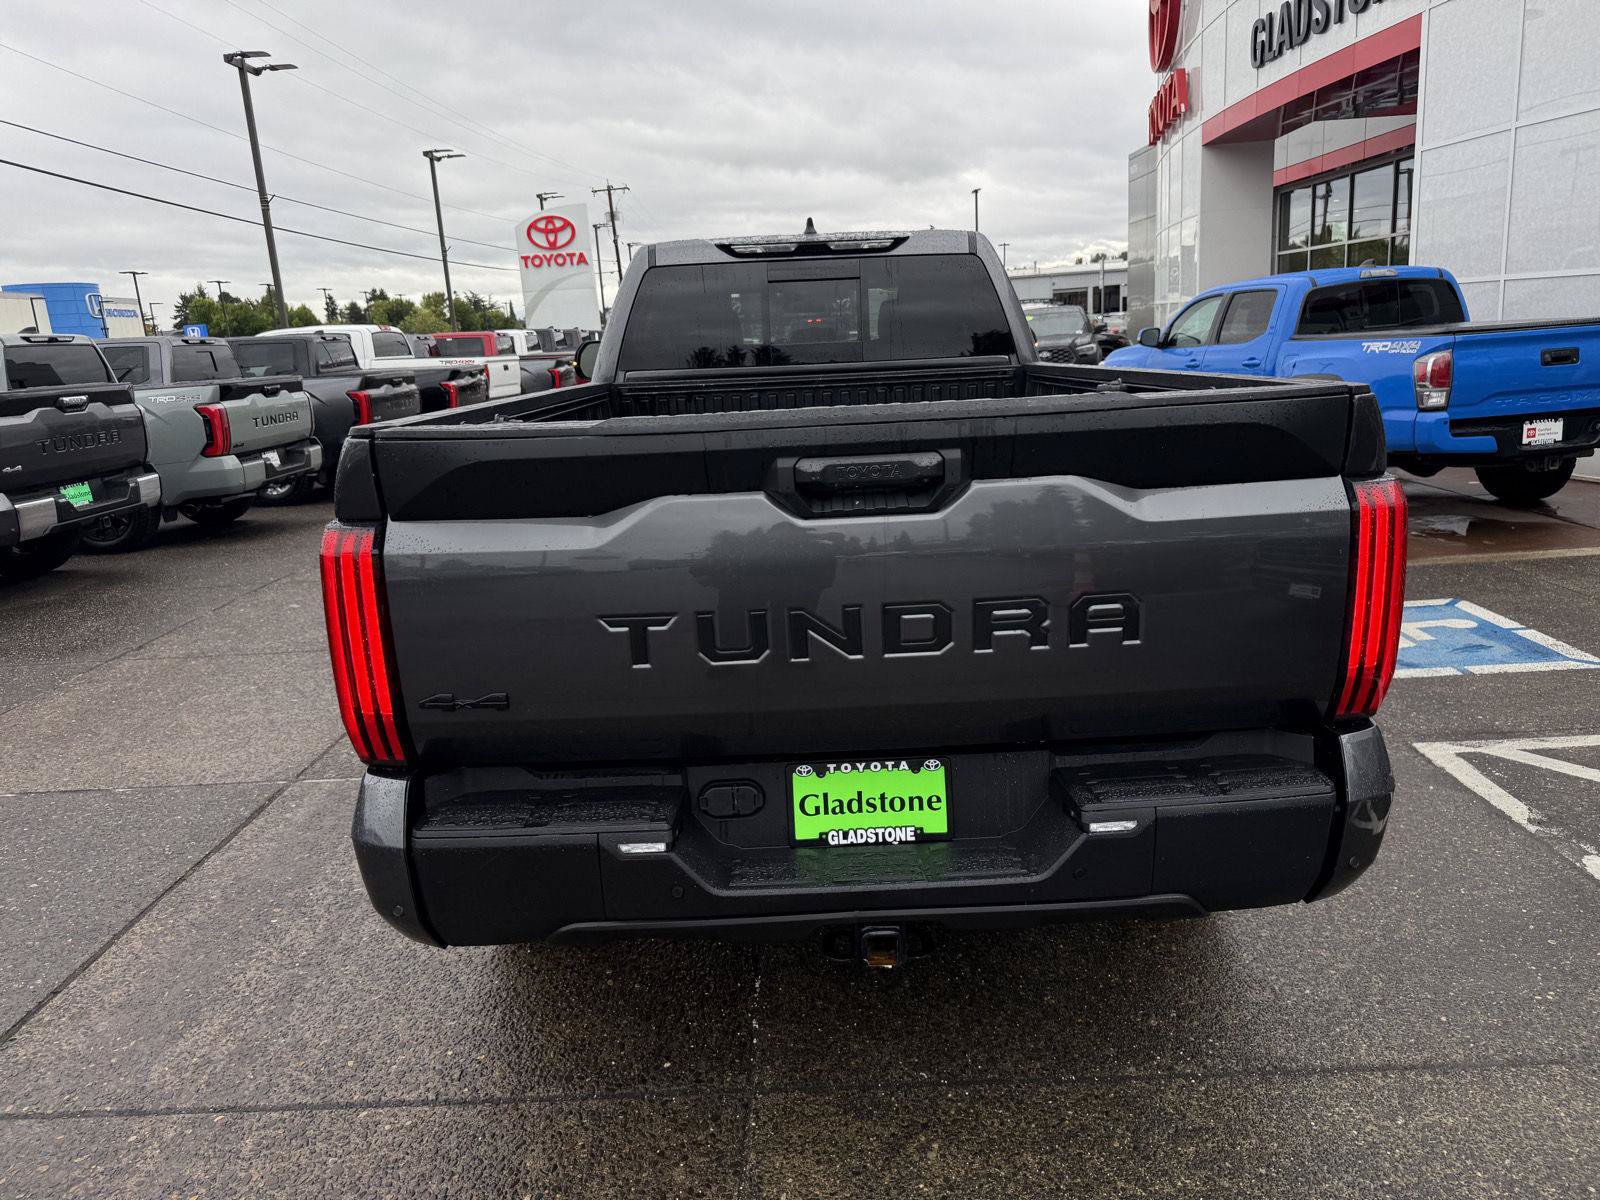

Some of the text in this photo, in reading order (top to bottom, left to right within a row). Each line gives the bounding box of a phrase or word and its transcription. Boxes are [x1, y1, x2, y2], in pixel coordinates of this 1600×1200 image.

[520, 251, 589, 269] TOYOTA
[1361, 341, 1391, 354] TRD
[148, 395, 176, 404] TRD
[251, 411, 299, 429] TUNDRA
[34, 429, 122, 455] TUNDRA
[836, 463, 903, 480] TOYOTA
[597, 592, 1142, 670] TUNDRA
[826, 760, 910, 774] TOYOTA
[798, 790, 943, 817] Gladstone
[827, 826, 917, 846] GLADSTONE
